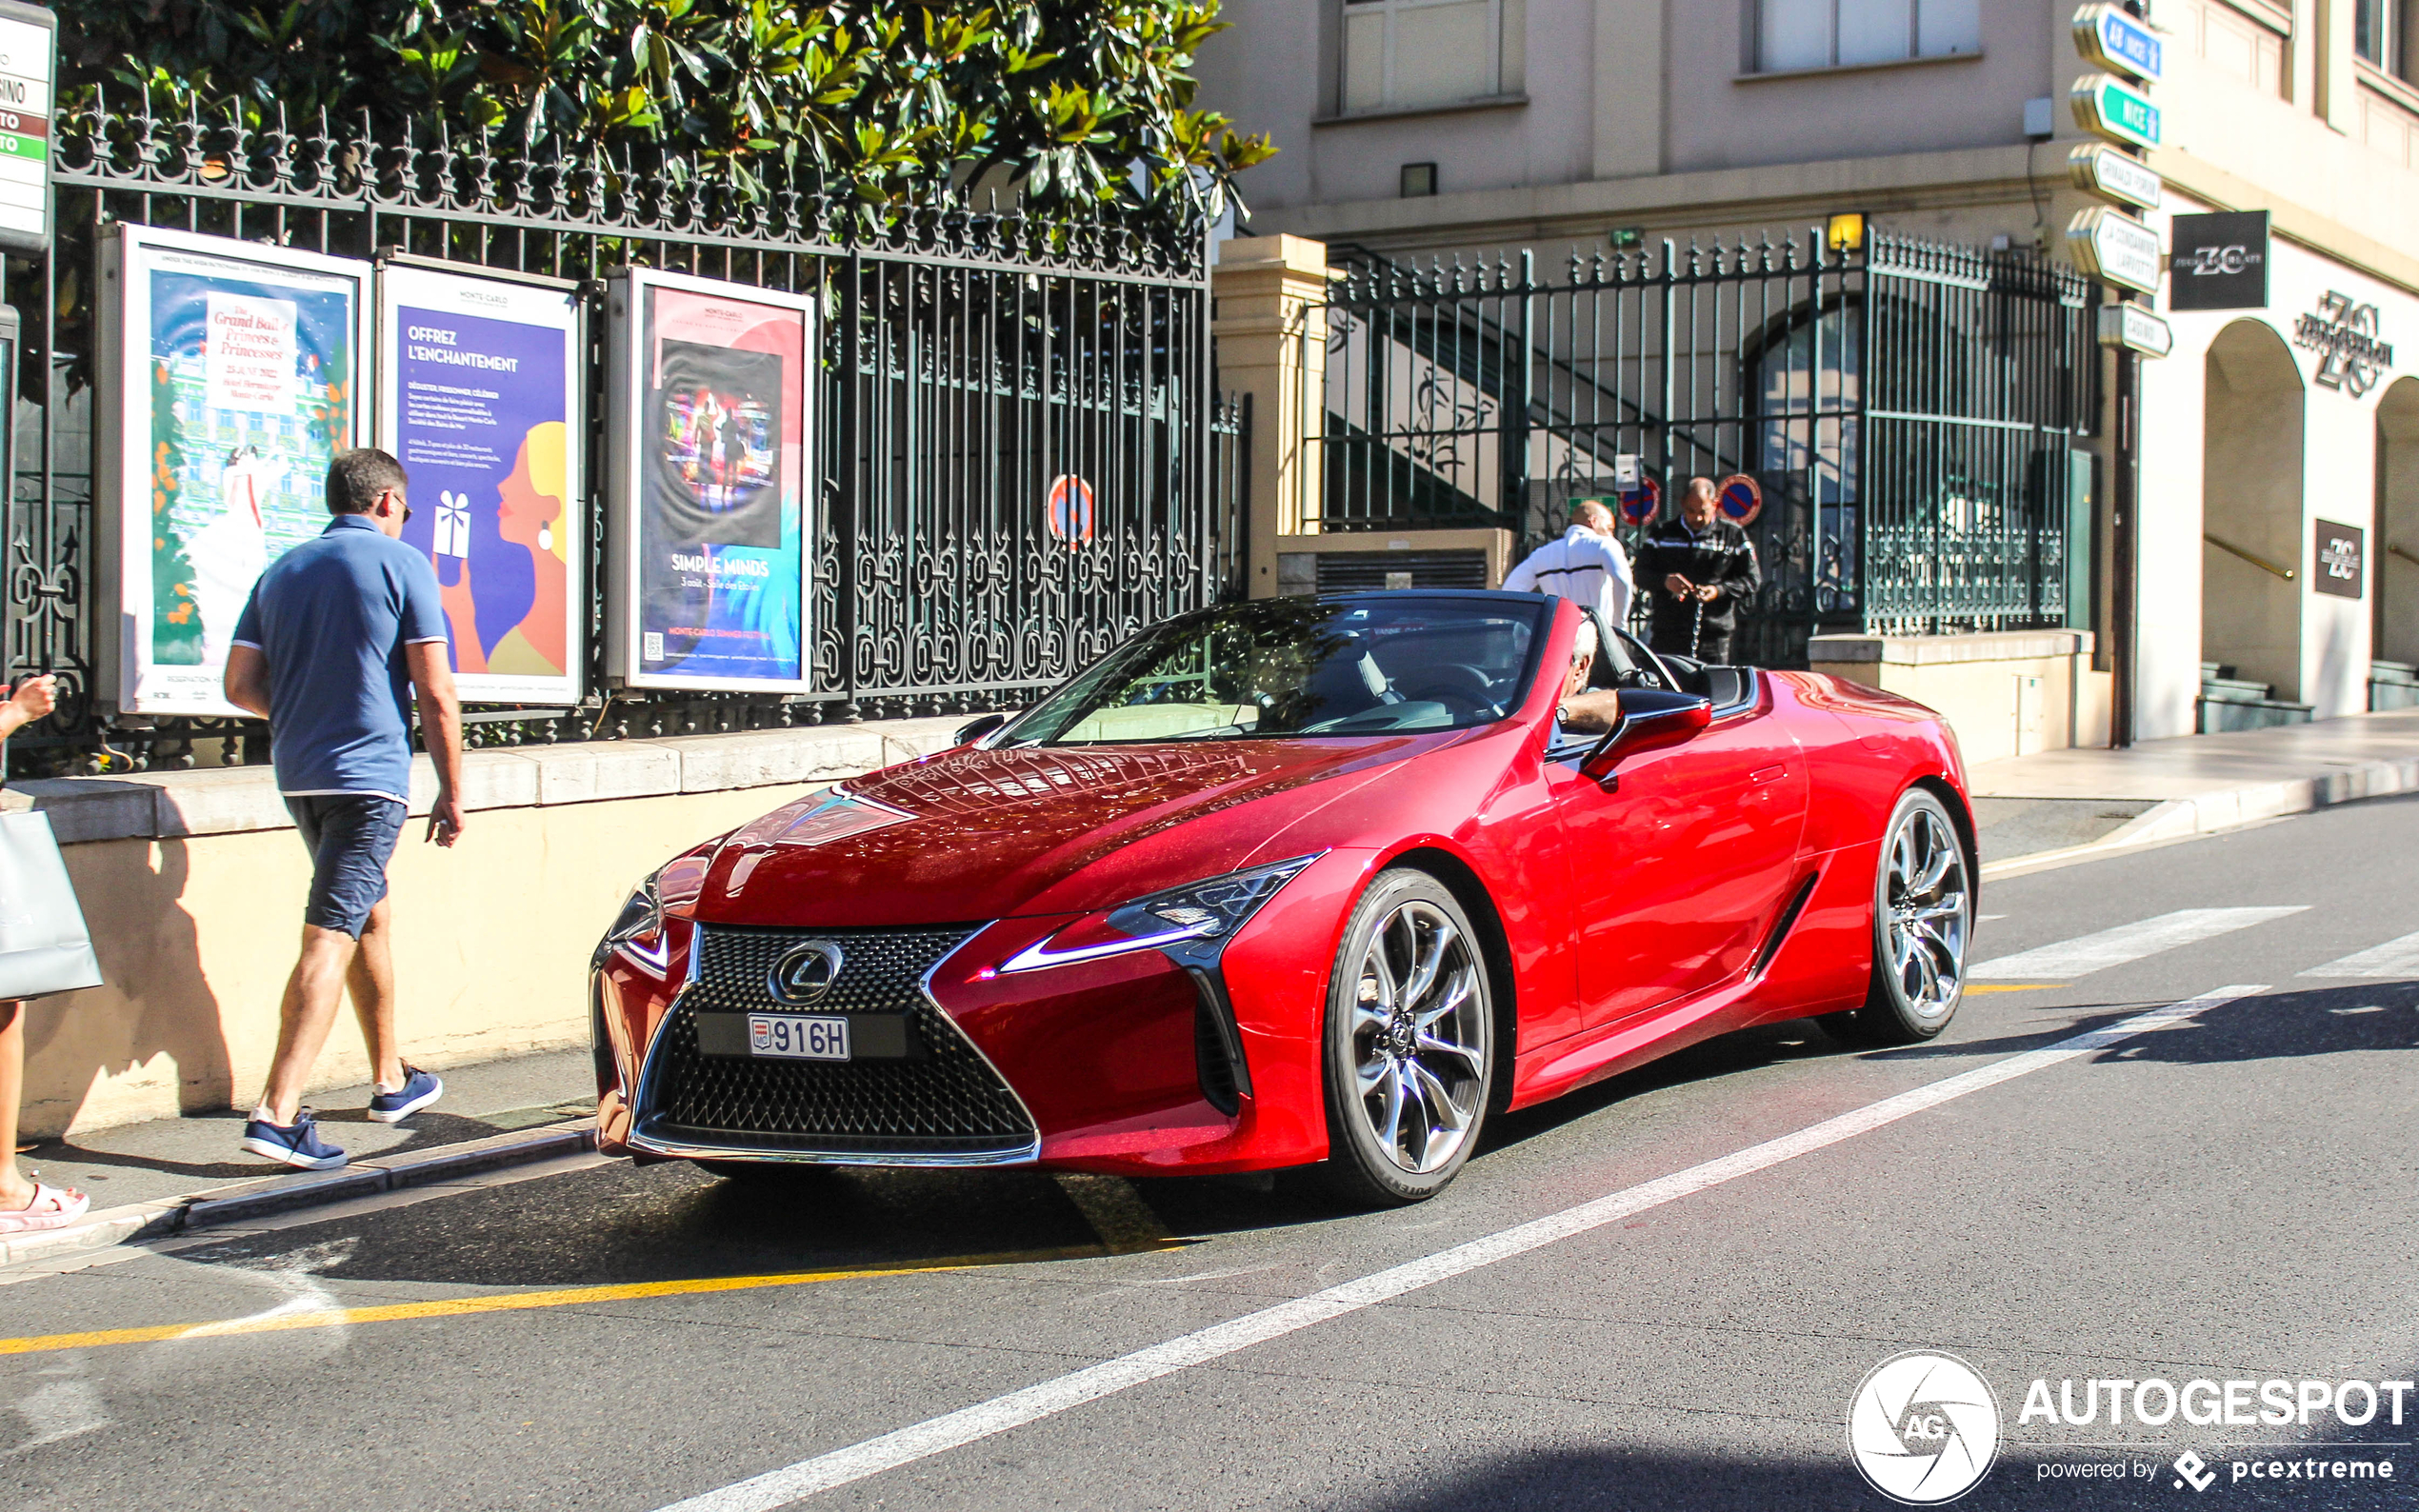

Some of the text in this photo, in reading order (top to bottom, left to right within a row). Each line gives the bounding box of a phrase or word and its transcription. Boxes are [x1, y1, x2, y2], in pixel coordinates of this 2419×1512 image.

[2123, 99, 2147, 131] NICE
[214, 311, 253, 328] Grand
[256, 316, 279, 331] Ball
[226, 328, 270, 344] Princes
[408, 325, 457, 346] OFFREZ
[221, 341, 283, 361] Princesses
[408, 345, 519, 373] L'ENCHANTEMENT
[671, 553, 770, 578] SIMPLE MINDS
[680, 576, 687, 587] 3
[707, 578, 724, 589] Salle
[725, 580, 737, 589] des
[755, 1035, 769, 1045] MC
[774, 1021, 843, 1055] 916H
